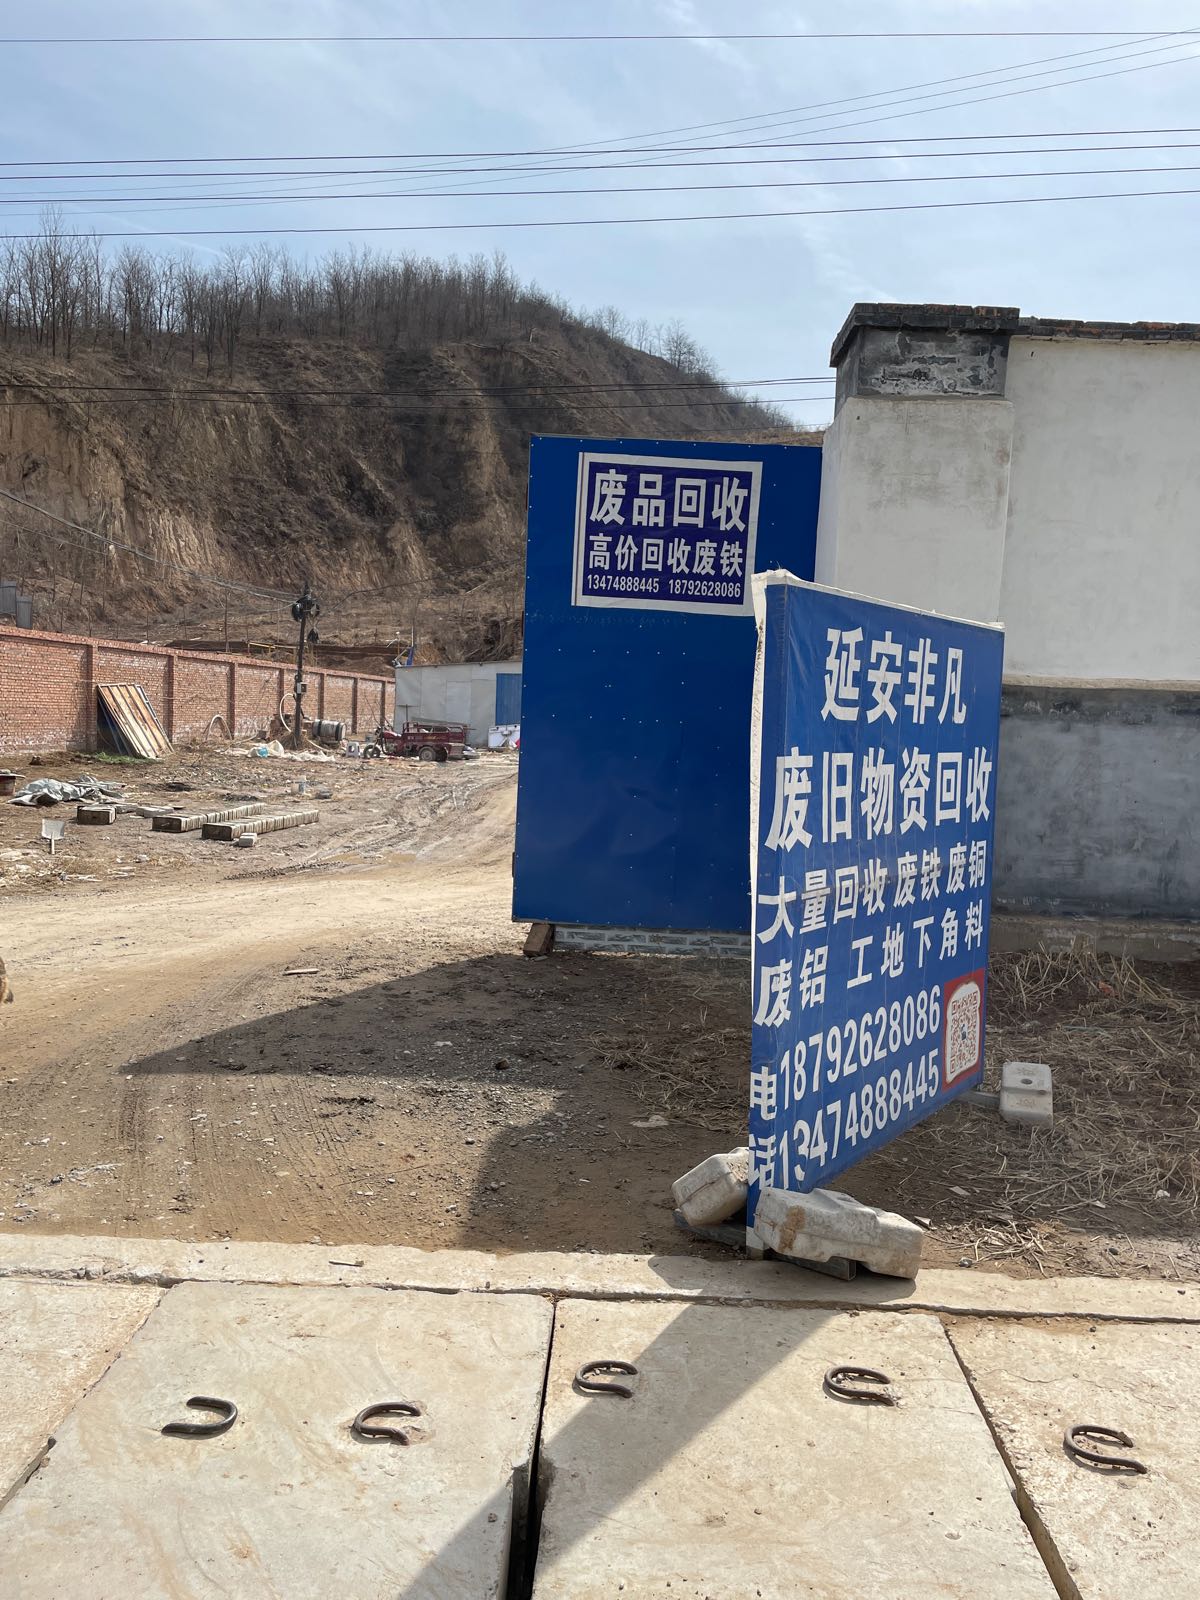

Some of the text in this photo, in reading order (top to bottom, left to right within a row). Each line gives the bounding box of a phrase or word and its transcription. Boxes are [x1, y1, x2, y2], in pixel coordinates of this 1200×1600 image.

[589, 469, 749, 533] 废品回收
[587, 574, 741, 598] 13474888445 18792628086
[588, 533, 743, 578] 高价回收废铁
[820, 626, 967, 725] 延安非凡
[764, 746, 993, 852] 废旧物资回收
[780, 985, 941, 1111] 18792628086
[779, 1048, 940, 1191] 13474888445
